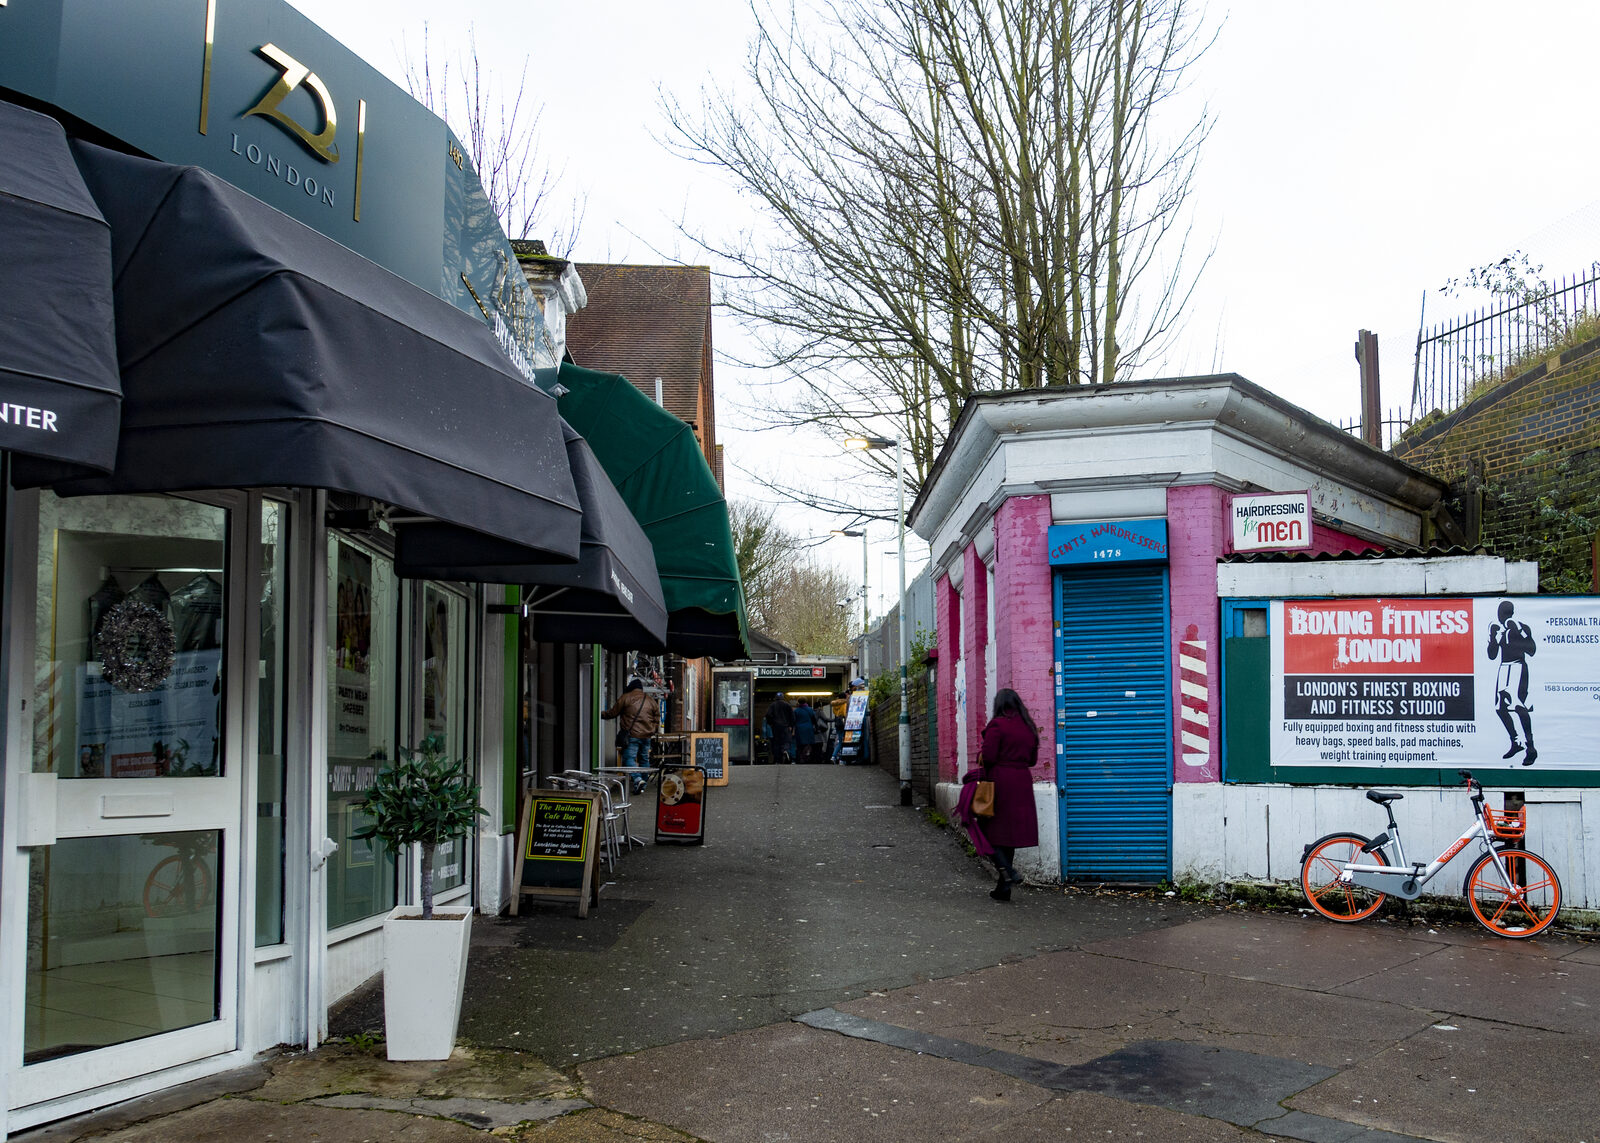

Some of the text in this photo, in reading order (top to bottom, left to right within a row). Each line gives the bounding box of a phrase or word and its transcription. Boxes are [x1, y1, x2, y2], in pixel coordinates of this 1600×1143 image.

[231, 132, 335, 208] LONDON
[1236, 502, 1305, 518] HAIRDRESSING
[1257, 520, 1302, 543] MEN
[1051, 523, 1166, 559] GENTS HAIRDRESSERS
[1093, 549, 1121, 559] 1478
[1288, 604, 1470, 636] BOXING FITNESS
[1549, 617, 1600, 626] PERSONAL TR
[1546, 635, 1599, 644] YOGA CLASSES
[1335, 636, 1421, 665] LONDON
[761, 667, 811, 677] Norbury Station
[1296, 681, 1460, 697] LONDON'S FINEST BOXING
[1310, 699, 1446, 715] AND FITNESS STUDIO
[1283, 722, 1476, 735] Fully equipped boxing and fitness studio with
[1295, 736, 1464, 749] heavy bags, speed balls, pad machines,
[1320, 750, 1438, 763] weight training equipment.
[555, 804, 584, 813] Railway
[544, 812, 560, 820] Cafe
[1442, 839, 1465, 861] mobike
